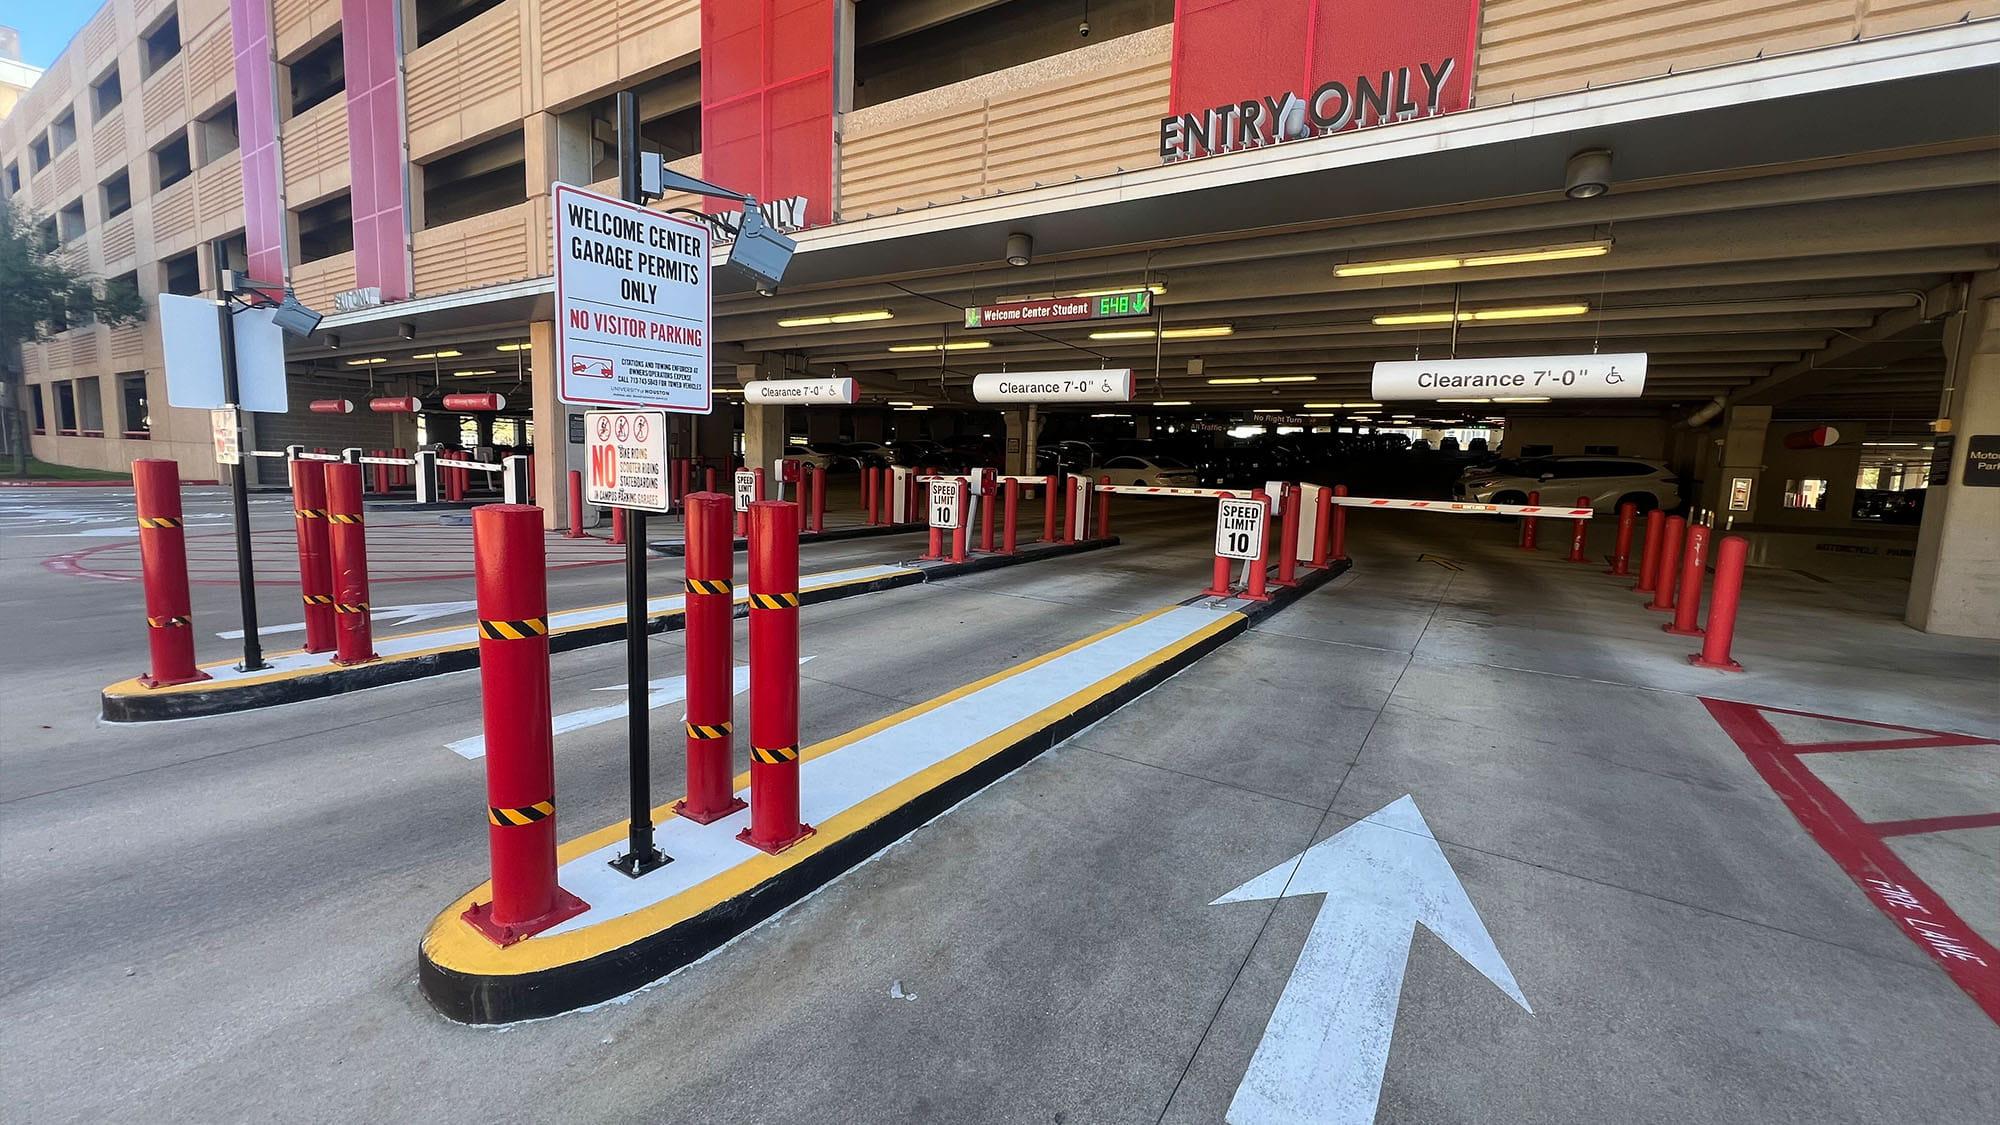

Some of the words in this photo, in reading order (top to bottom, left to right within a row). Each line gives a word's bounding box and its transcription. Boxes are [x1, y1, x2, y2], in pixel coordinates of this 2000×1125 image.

[1160, 91, 1296, 160] ENTRY
[1310, 58, 1455, 131] ONLY
[568, 203, 645, 243] WELCOME
[649, 226, 701, 258] CENTER
[571, 236, 633, 271] GARAGE
[638, 252, 699, 285] PERMITS
[621, 278, 657, 304] ONLY
[984, 308, 1021, 321] Welcome
[1022, 305, 1051, 318] Center
[1052, 302, 1089, 316] Student
[1100, 296, 1129, 314] 648
[570, 309, 589, 330] NO
[594, 312, 647, 339] VISITOR
[650, 323, 702, 347] PARKING
[621, 358, 644, 368] CITATIONS
[645, 361, 654, 369] AND
[655, 362, 671, 371] TOWING
[671, 364, 692, 373] ENFORCED
[618, 375, 629, 384] CALL
[658, 379, 667, 387] FOR
[682, 382, 702, 391] VEHICLES
[1417, 372, 1526, 388] Clearance
[1532, 369, 1588, 386] 7'-0"
[761, 387, 802, 398] Clearance
[803, 385, 824, 396] 7'-0"
[999, 382, 1060, 394] Clearance
[1063, 381, 1094, 393] 7'-0"
[1265, 415, 1285, 423] Right
[1286, 416, 1302, 424] Turn
[592, 444, 617, 489] NO
[642, 463, 659, 475] RIDING
[737, 475, 754, 484] SPEED
[738, 484, 752, 492] LIMIT
[933, 485, 955, 495] SPEED
[599, 490, 617, 502] CAMPUS
[740, 494, 751, 507] 10
[934, 495, 954, 505] LIMIT
[937, 507, 950, 523] 10
[1223, 505, 1259, 519] SPEED
[1224, 518, 1256, 531] LIMIT
[1228, 532, 1250, 553] 10
[1865, 878, 1933, 915] FIRE
[1903, 917, 1988, 968] LANE
